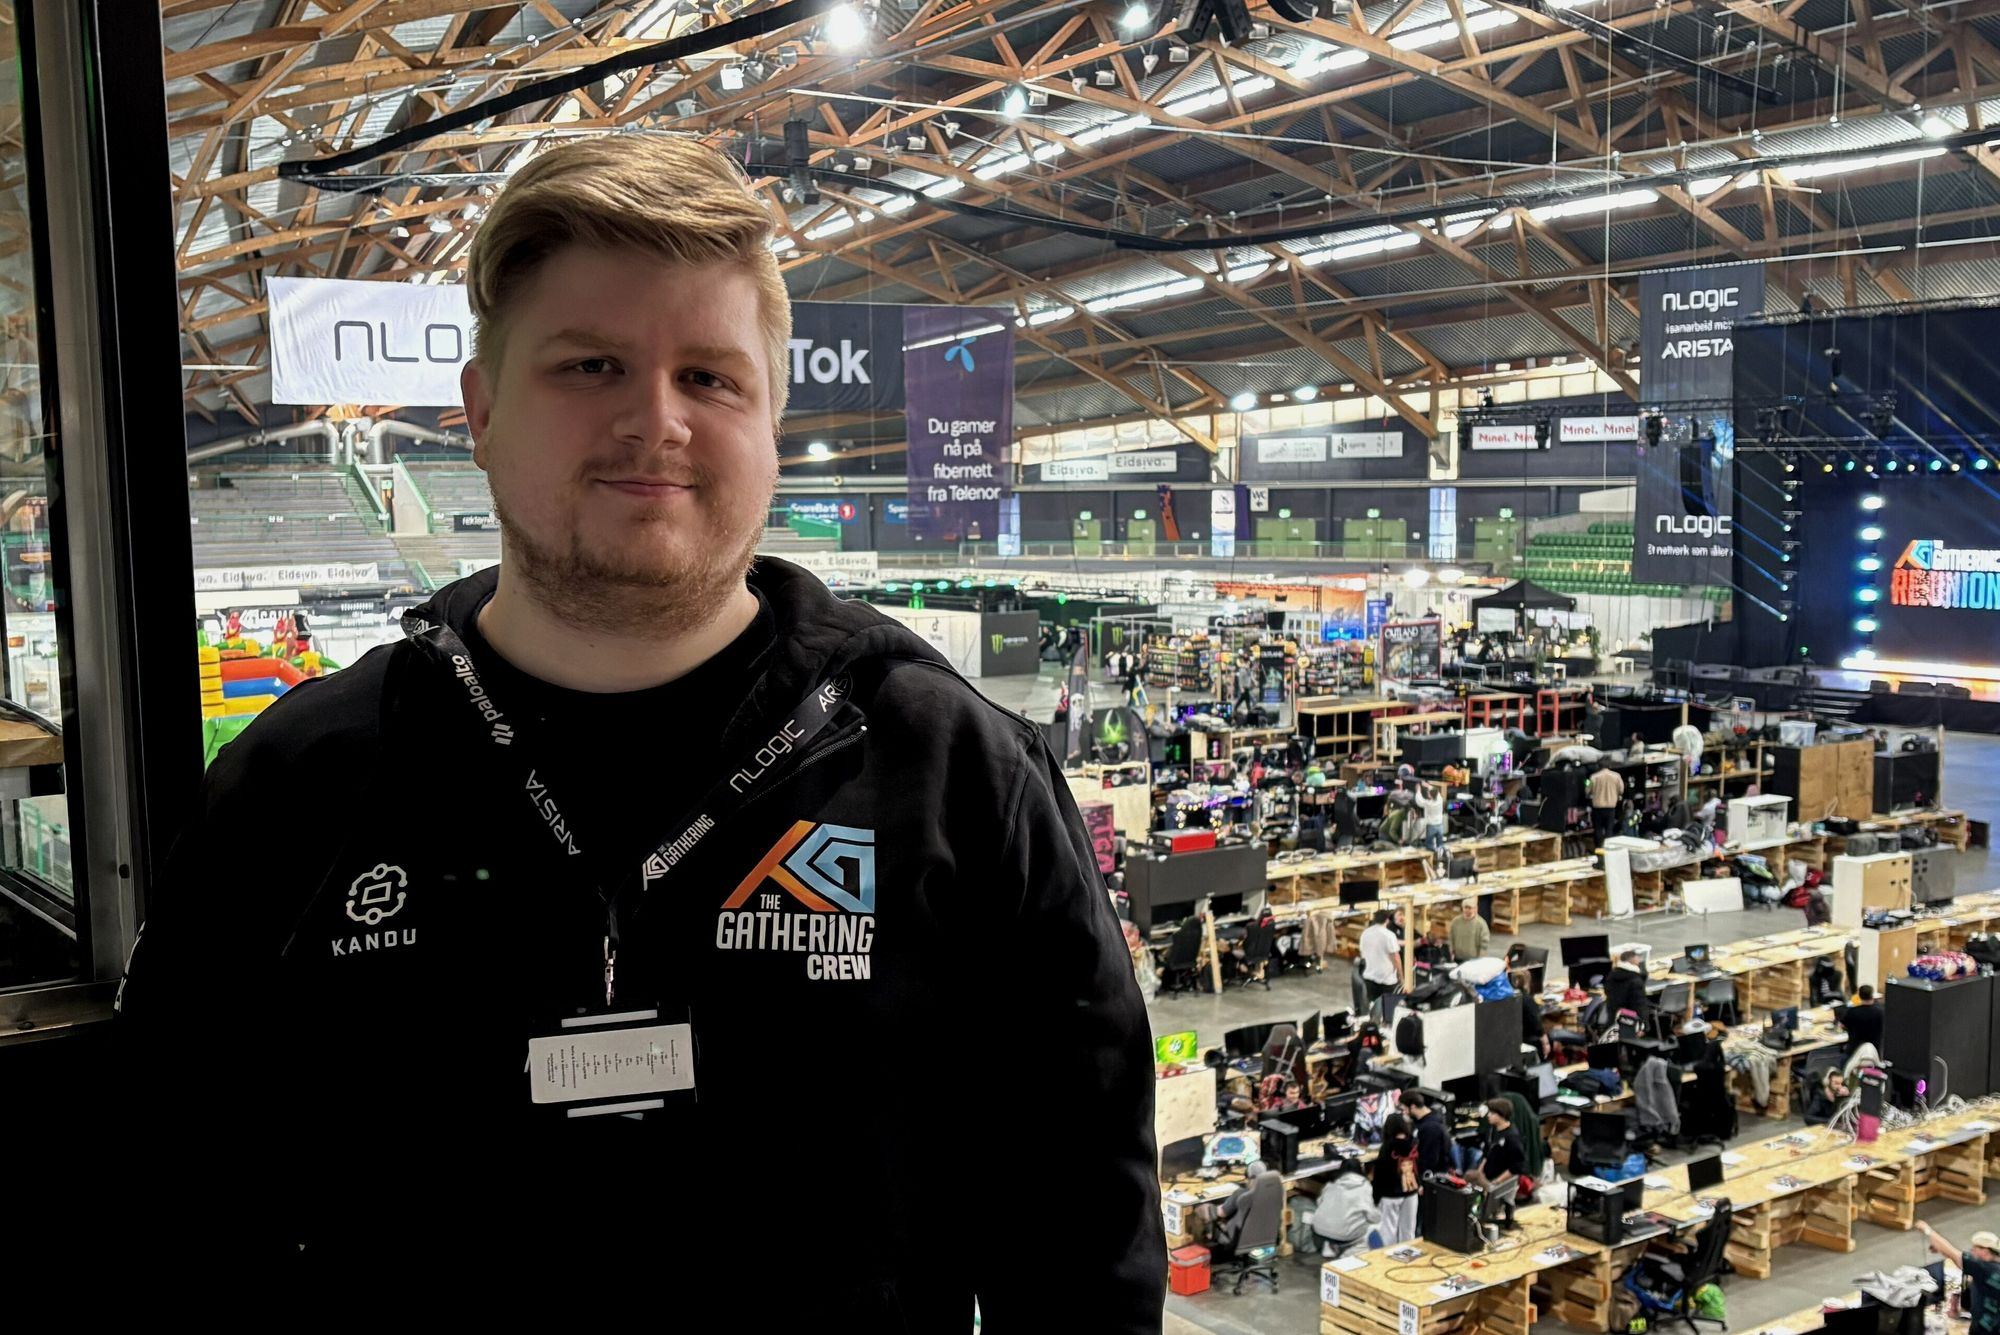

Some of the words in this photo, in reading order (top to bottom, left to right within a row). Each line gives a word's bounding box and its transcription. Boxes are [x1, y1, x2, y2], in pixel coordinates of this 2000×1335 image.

[1661, 338, 1734, 359] ARISTA
[928, 418, 949, 434] Du
[950, 420, 996, 437] gamer
[943, 438, 961, 456] nå
[963, 437, 982, 459] på
[934, 463, 993, 479] fibernett
[928, 487, 948, 502] fra
[948, 485, 1001, 501] Telenor
[452, 654, 504, 722] paloalto
[525, 769, 581, 855] ARISTA
[662, 814, 716, 866] GATHERING
[760, 893, 781, 910] THE
[331, 928, 417, 956] KANDU
[716, 911, 876, 953] GATHERING
[807, 953, 871, 980] CREW
